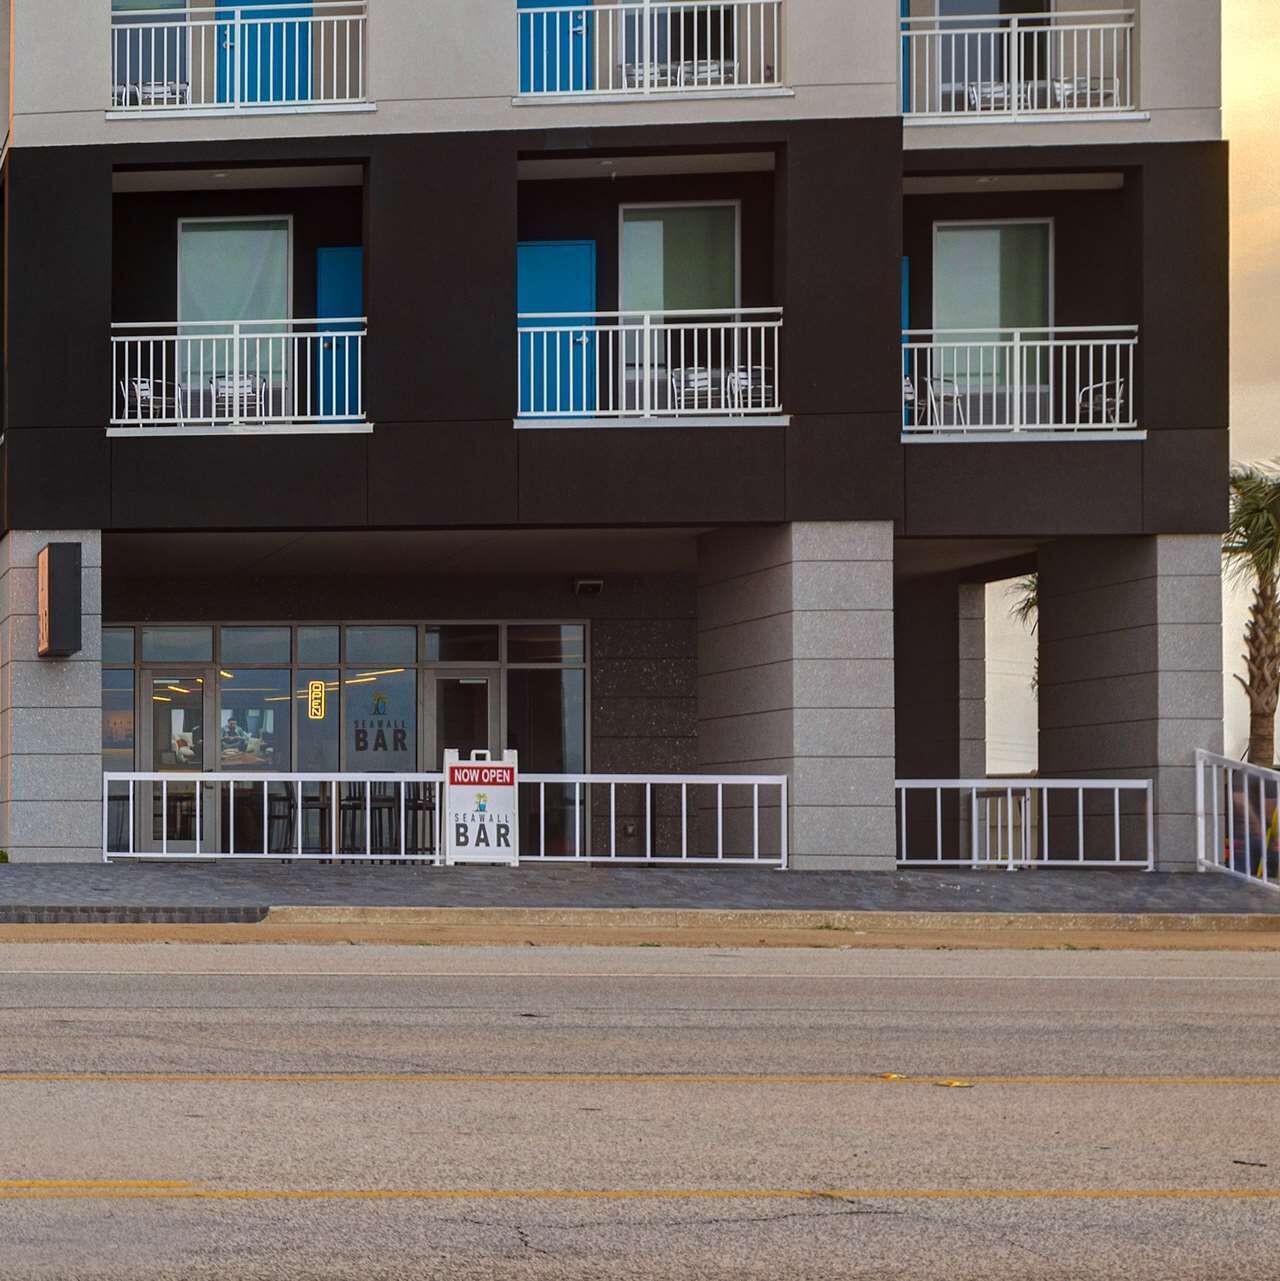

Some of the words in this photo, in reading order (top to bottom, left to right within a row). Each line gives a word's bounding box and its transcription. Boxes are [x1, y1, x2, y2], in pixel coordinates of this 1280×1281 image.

[311, 683, 322, 717] OPEN
[354, 720, 407, 728] SEAWALL
[355, 729, 408, 751] BAR
[454, 769, 480, 782] NOW
[482, 769, 510, 782] OPEN
[454, 813, 509, 823] SEAWALL
[455, 823, 511, 847] BAR
